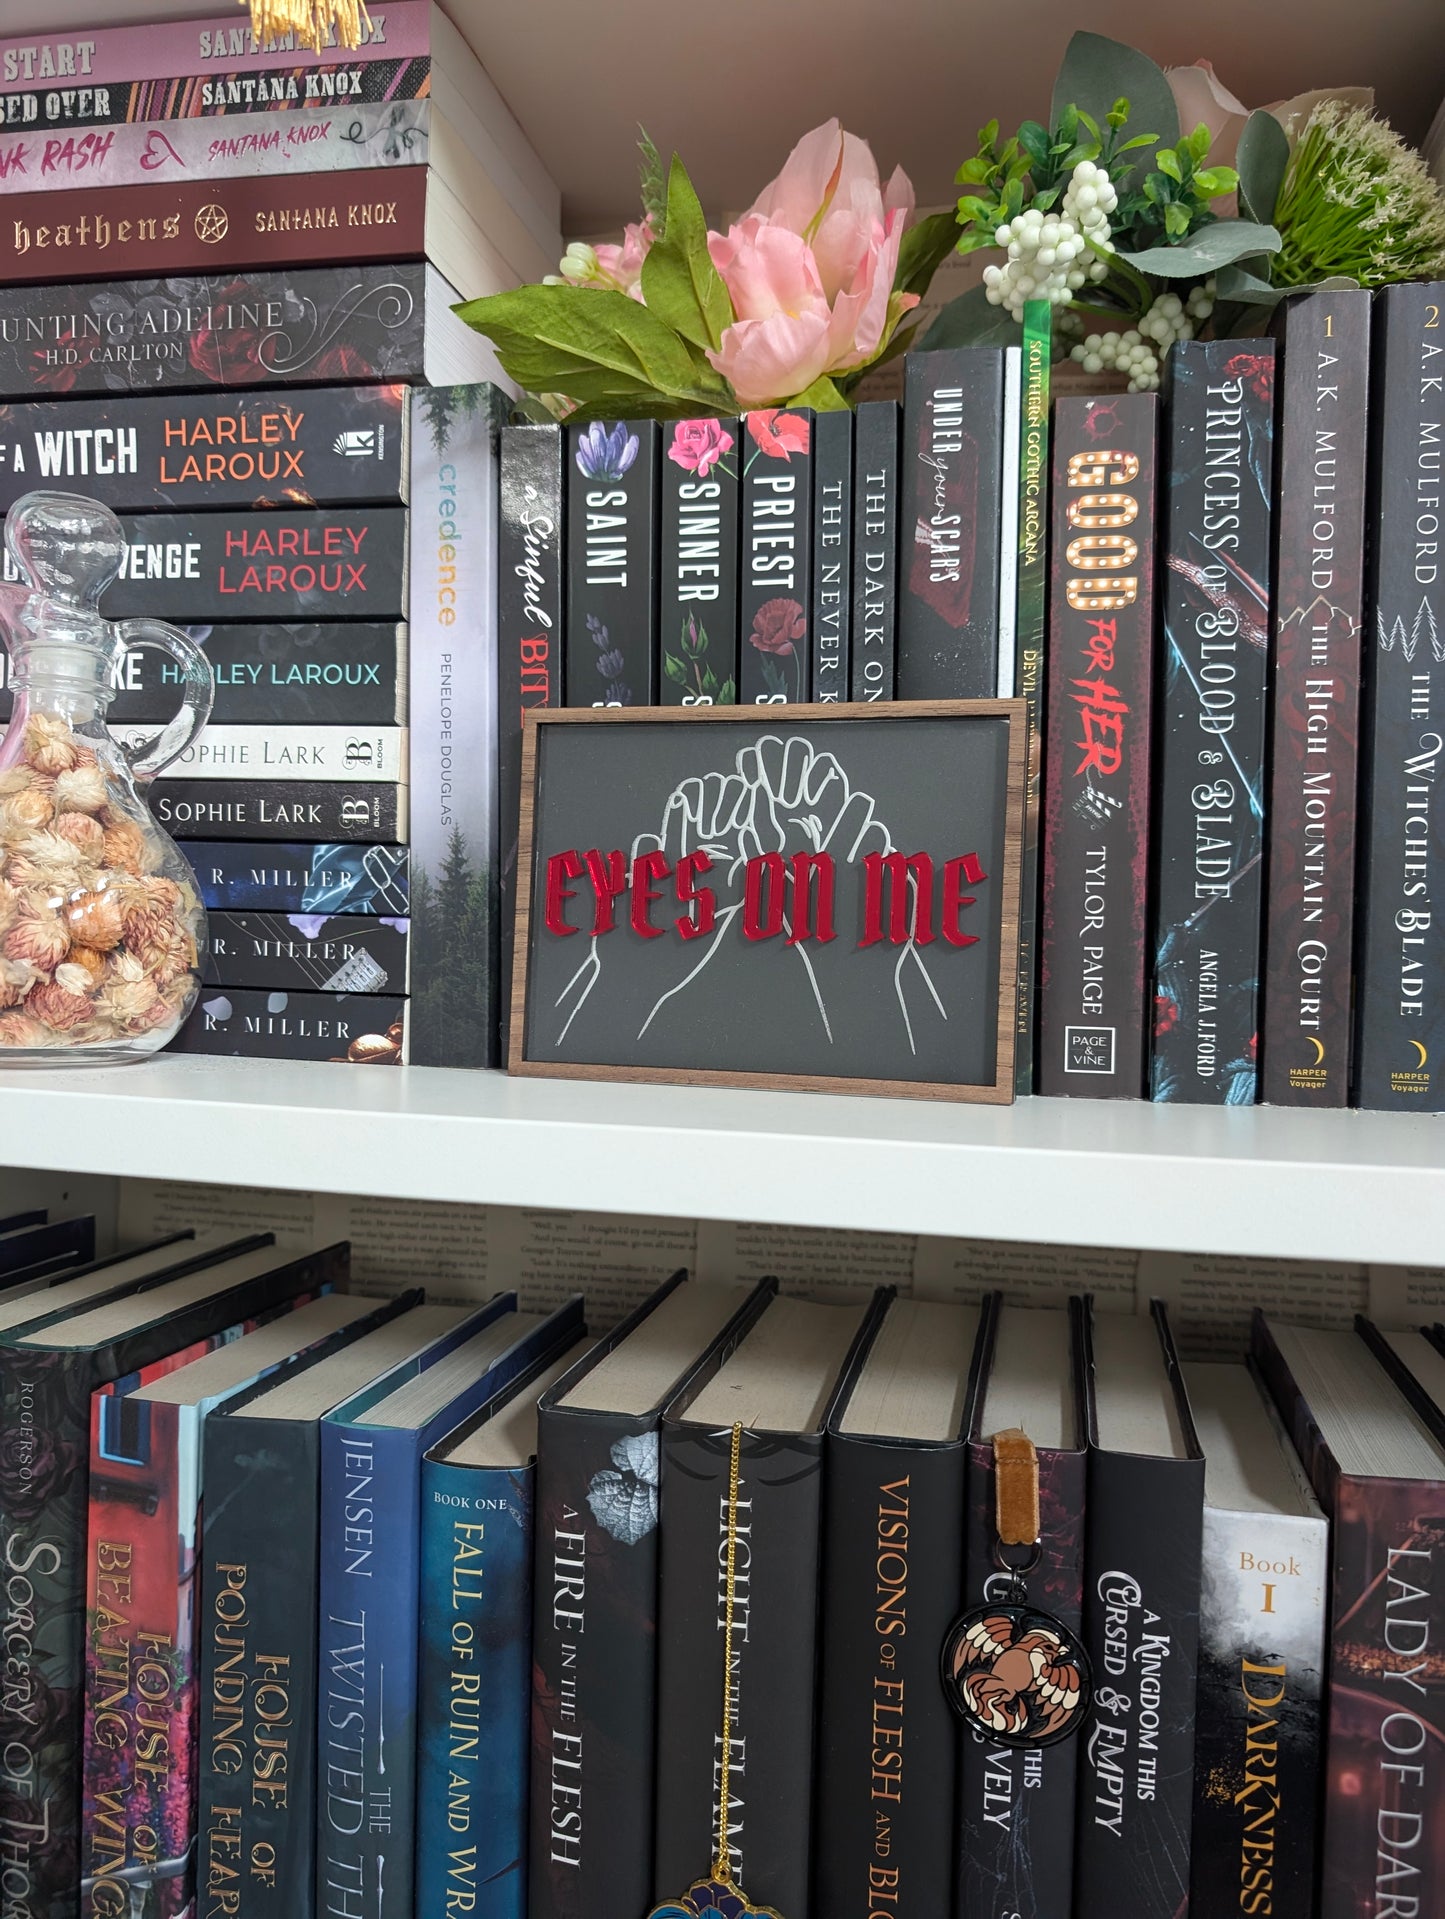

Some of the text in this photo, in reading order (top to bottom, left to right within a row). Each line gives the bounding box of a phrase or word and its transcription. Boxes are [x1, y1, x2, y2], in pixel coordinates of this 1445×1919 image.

[3, 41, 96, 82] START
[202, 71, 362, 106] SANTANA KNOX
[46, 88, 111, 121] OVER
[41, 131, 116, 177] RASH
[208, 121, 332, 162] SANTANA KNOX
[13, 212, 182, 256] heathens
[348, 202, 398, 226] KNOX
[139, 301, 285, 335] ADELINE
[1323, 314, 1335, 338] 1
[1424, 305, 1440, 328] 2
[46, 342, 184, 367] H.D. CARLTON
[13, 443, 26, 473] A
[34, 427, 138, 477] WITCH
[163, 413, 305, 447] HARLEY
[1024, 340, 1042, 567] SOUTHERN GOTHIC ARCANA
[159, 449, 305, 484] LAROUX
[918, 387, 963, 584] UNDER your SCARS
[1311, 351, 1340, 590] A.K. MULFORD
[1414, 342, 1444, 585] A.K. MULFORD
[751, 475, 796, 590] PRIEST
[821, 480, 843, 547] THE
[864, 469, 887, 537] THE
[1065, 450, 1140, 611] GOOD
[225, 526, 369, 558] HARLEY
[437, 463, 462, 627] credence
[514, 485, 555, 629] a Sinful
[585, 490, 628, 588] SAINT
[677, 482, 721, 603] SINNER
[218, 563, 368, 594] LAROUX
[863, 551, 885, 646] DARK
[820, 562, 842, 675] NEVER
[1079, 617, 1118, 673] FOR
[1191, 376, 1243, 900] PRINCESS OF BLOOD & BLADE
[271, 663, 381, 685] LAROUX
[519, 632, 550, 730] BIT
[1022, 650, 1037, 698] DEVIL
[1410, 671, 1431, 721] THE
[178, 741, 327, 765] OPHIE LARK
[440, 653, 452, 827] PENELOPE DOUGLAS
[1067, 677, 1131, 777] HER
[159, 798, 323, 824] SOPHIE LARK
[1296, 622, 1334, 1031] THE HIGH MOUNTAIN COURT
[211, 867, 353, 889] R. MILLER
[544, 848, 989, 948] EYES ON ME
[1079, 845, 1107, 938] TYLOR
[214, 938, 356, 961] R. MILLER
[1081, 945, 1104, 1016] PAIGE
[1198, 947, 1219, 1013] ANGELA
[1394, 907, 1432, 1017] BLADE
[204, 1014, 351, 1040] R. MILLER
[1071, 1035, 1107, 1048] PAGE
[1073, 1053, 1107, 1067] VINE
[1085, 1046, 1094, 1056] &
[1289, 1067, 1328, 1077] HARPER
[1289, 1079, 1327, 1089] Voyager
[1391, 1071, 1430, 1081] HARPER
[1391, 1083, 1429, 1093] Voyager
[18, 1382, 34, 1496] ROGERSON
[340, 1437, 374, 1579] JENSEN
[433, 1491, 508, 1511] BOOK ONE
[452, 1520, 485, 1610] FALL
[874, 1474, 910, 1636] VISIONS
[1239, 1551, 1302, 1577] Book
[2, 1532, 62, 1726] SORCERY
[1260, 1582, 1277, 1614] I
[1382, 1545, 1432, 1697] LADY
[451, 1622, 474, 1661] OF
[879, 1643, 896, 1671] OF
[449, 1671, 481, 1761] RUIN
[550, 1503, 586, 1871] A FIRE IN THE FLESH
[1087, 1569, 1142, 1837] CURSED & EMPTY
[1132, 1608, 1171, 1802] A KINGDOM THIS
[91, 1541, 133, 1919] BEATING WING
[132, 1631, 174, 1874] HOUSE OF
[205, 1561, 250, 1919] POUNDING HEAR
[327, 1608, 366, 1835] TWISTED
[871, 1676, 905, 1805] FLESH
[1380, 1711, 1427, 1788] OF
[3, 1741, 34, 1798] OF
[250, 1652, 293, 1888] HOUSE OF
[447, 1770, 472, 1833] AND
[1234, 1657, 1288, 1917] DARKNESS
[368, 1786, 391, 1835] THE
[875, 1810, 892, 1858] AND
